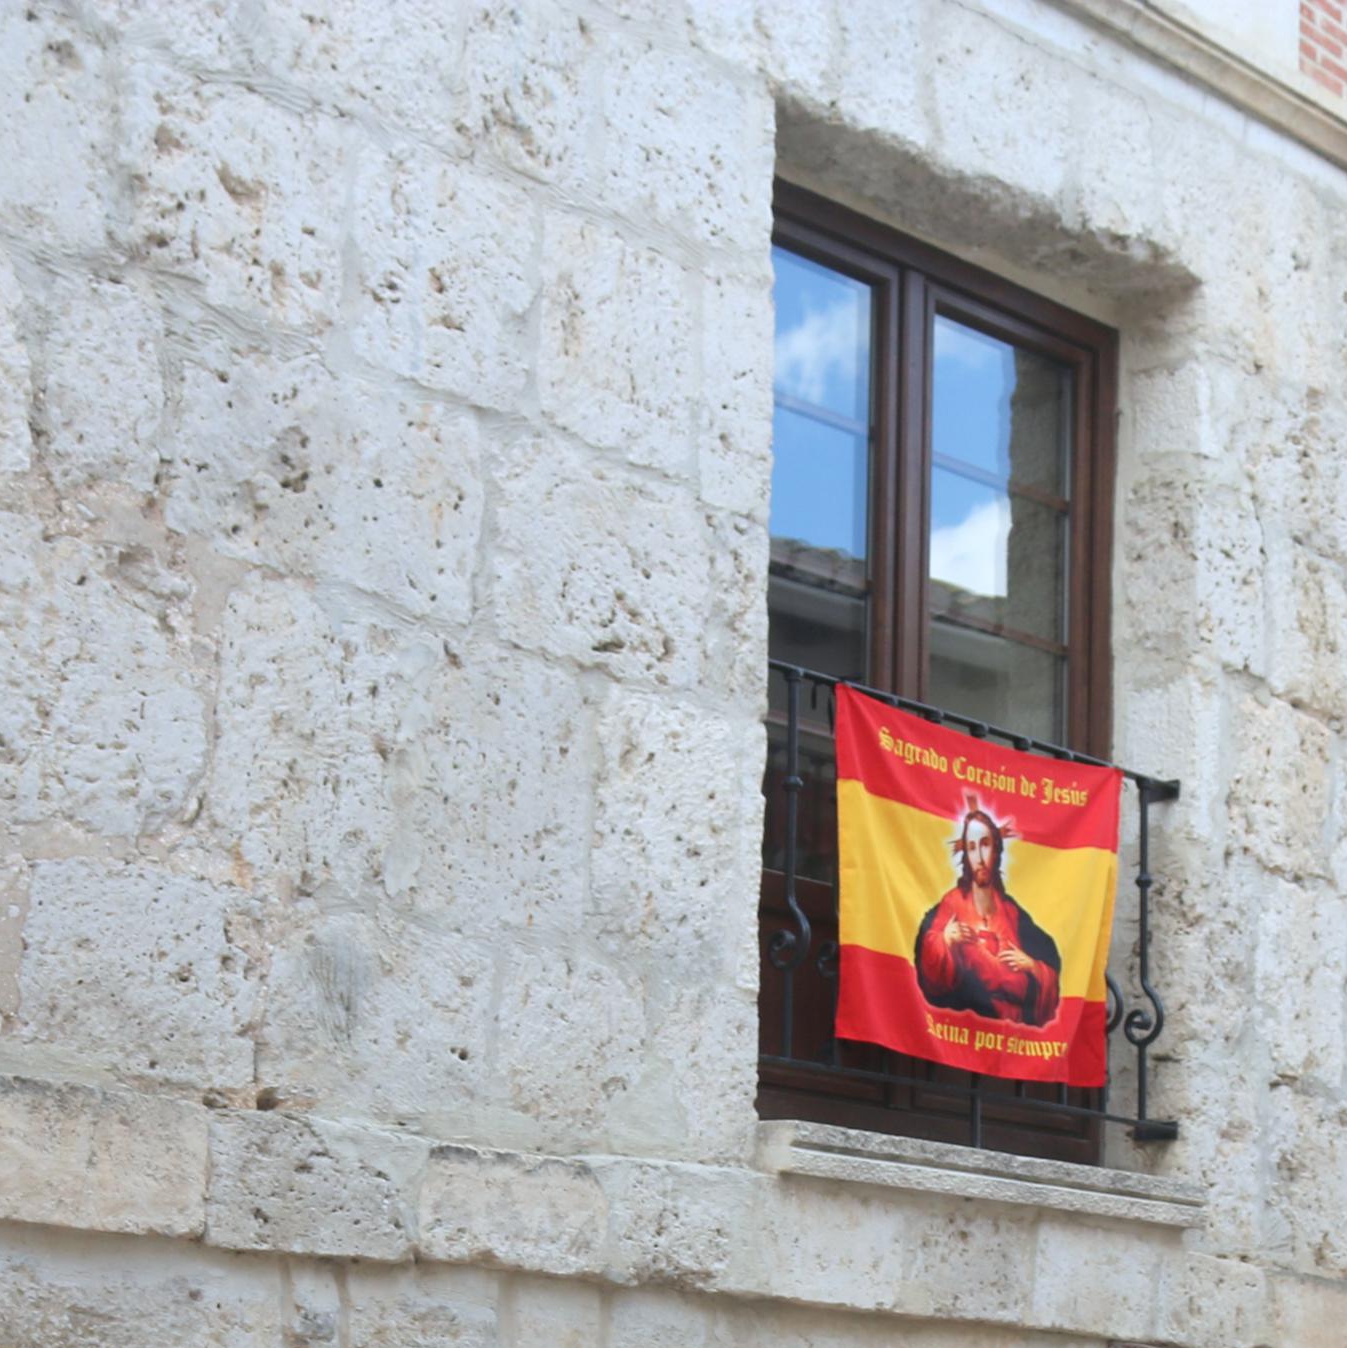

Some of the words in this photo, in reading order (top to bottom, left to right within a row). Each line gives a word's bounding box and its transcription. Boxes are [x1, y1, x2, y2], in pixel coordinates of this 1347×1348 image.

[878, 727, 948, 773] Sagrado
[953, 756, 1016, 793] Corazón
[1021, 774, 1037, 798] de
[1041, 778, 1088, 807] Jesús
[975, 1030, 1004, 1051] por
